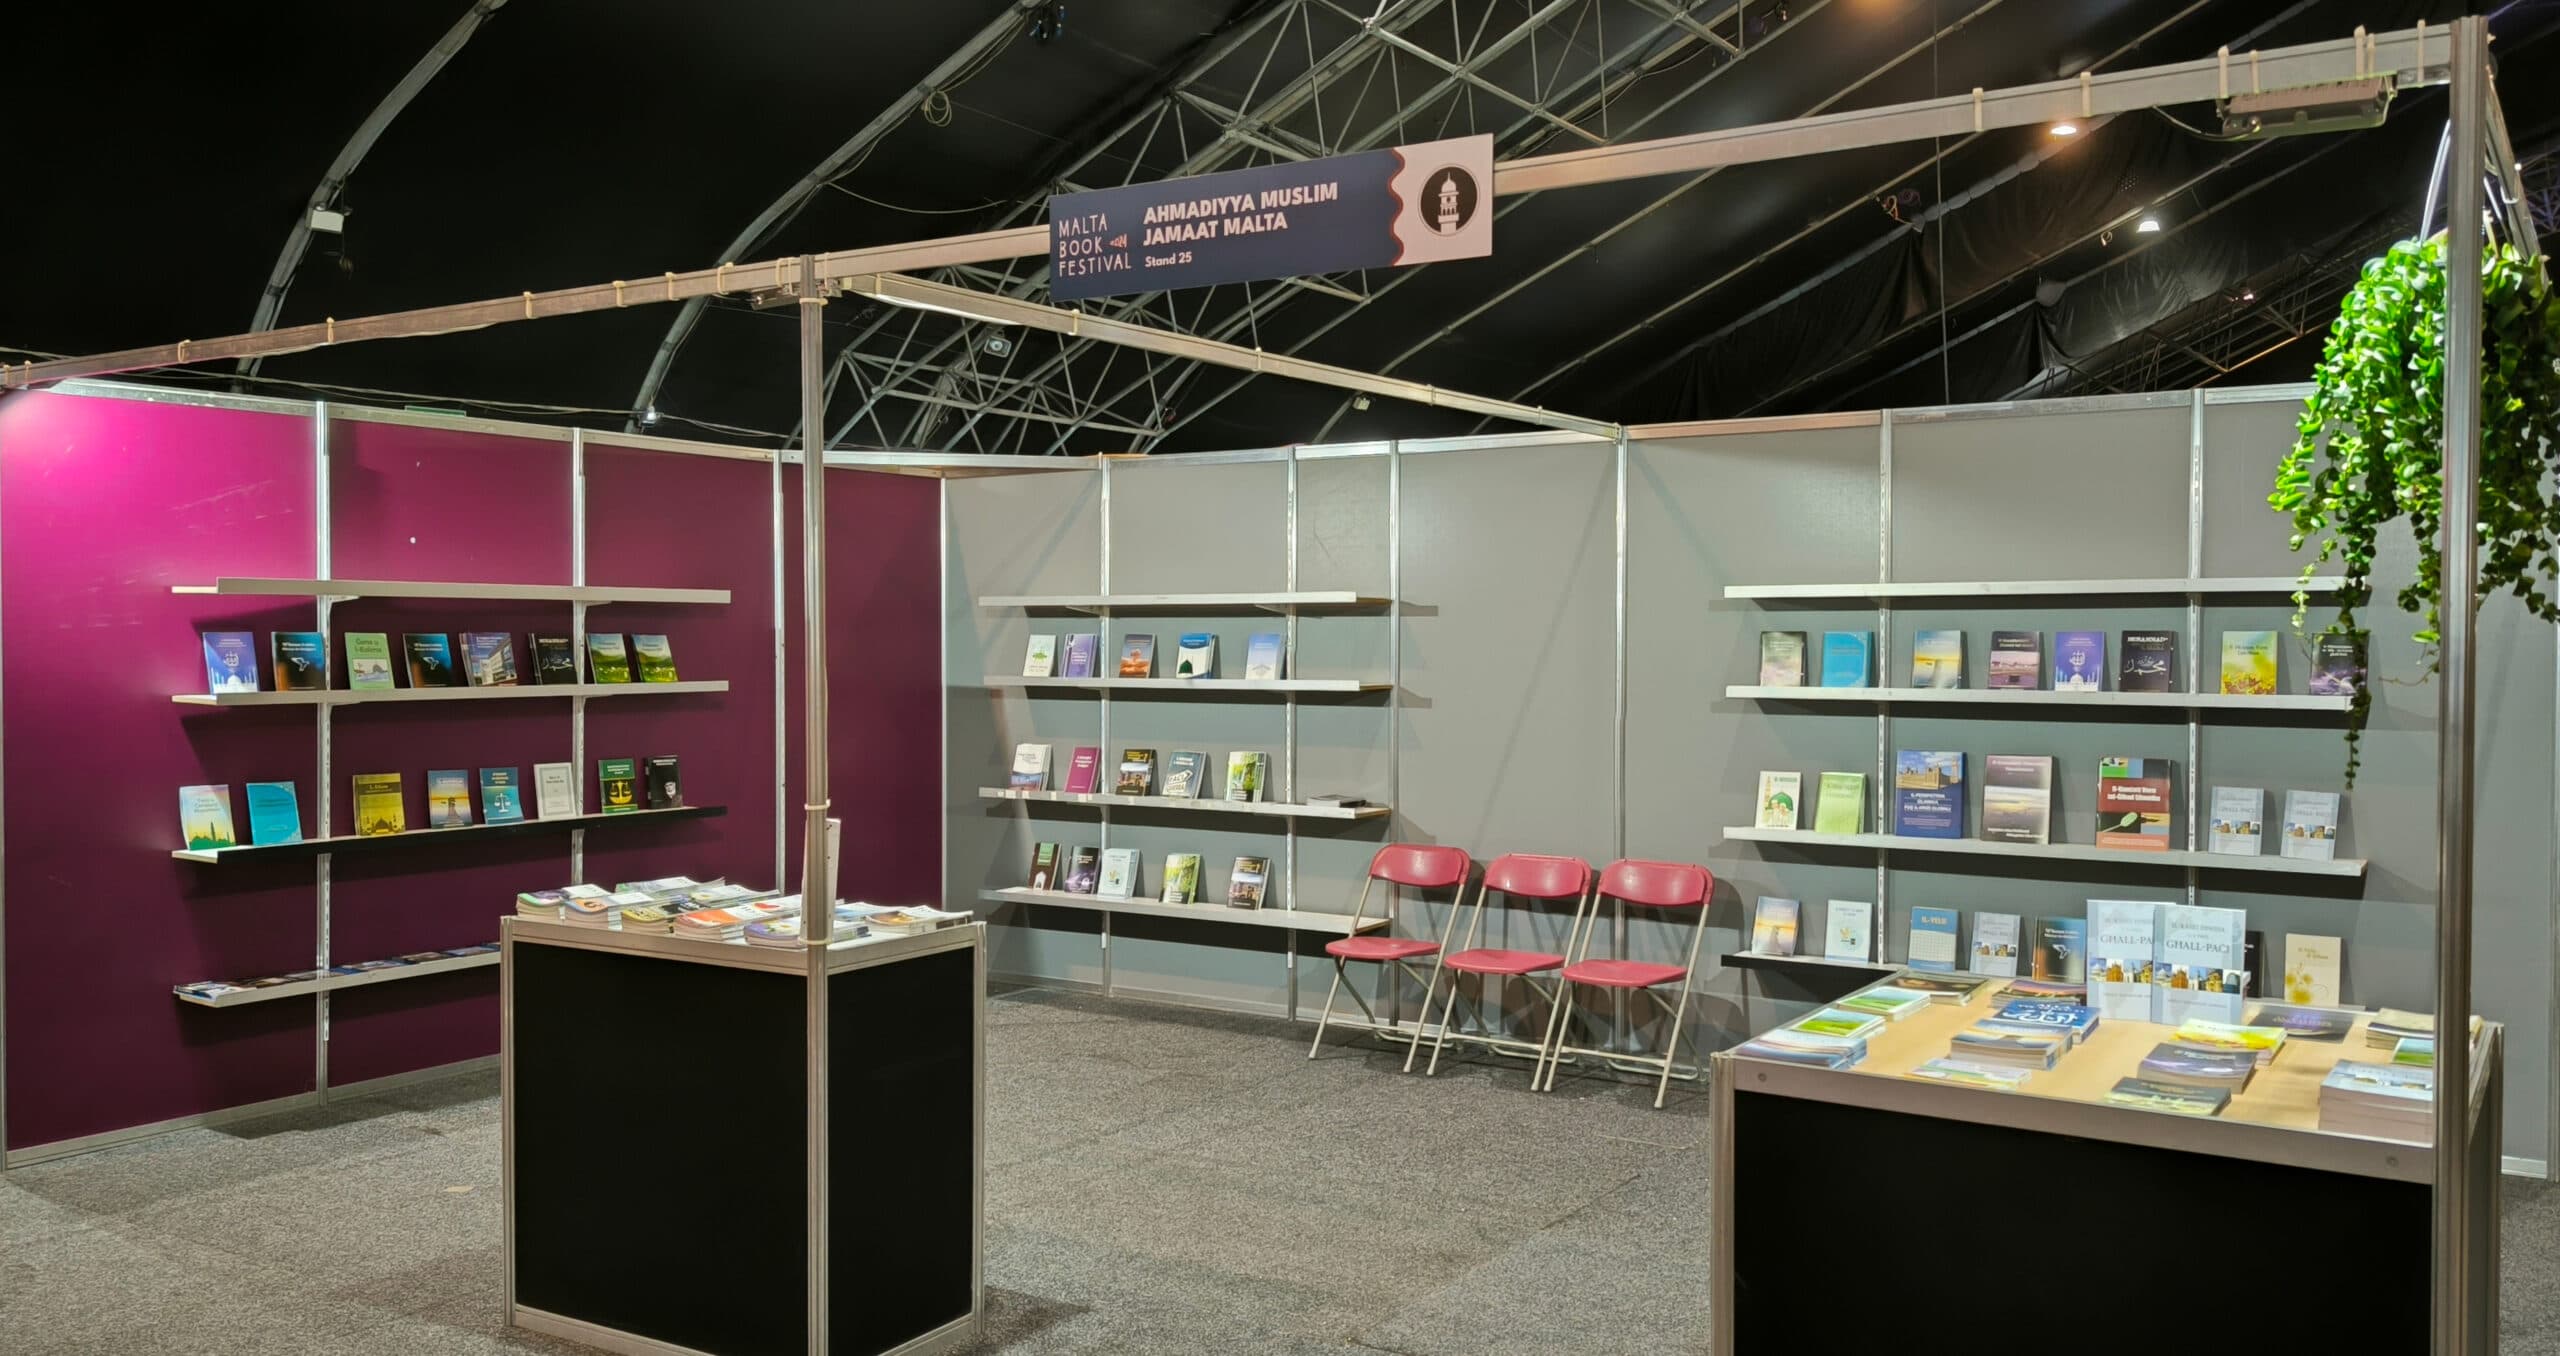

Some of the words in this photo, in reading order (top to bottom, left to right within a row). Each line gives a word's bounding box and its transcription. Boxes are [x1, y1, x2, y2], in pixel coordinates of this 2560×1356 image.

[1143, 194, 1256, 225] AHMADIYYA
[1261, 182, 1338, 209] MUSLIM
[1058, 213, 1108, 238] MALTA
[1143, 221, 1218, 246] JAMAAT
[1223, 212, 1288, 236] MALTA
[1059, 236, 1103, 258] BOOK
[1145, 253, 1176, 268] Stand
[1178, 251, 1192, 264] 25
[1058, 252, 1132, 277] FESTIVAL
